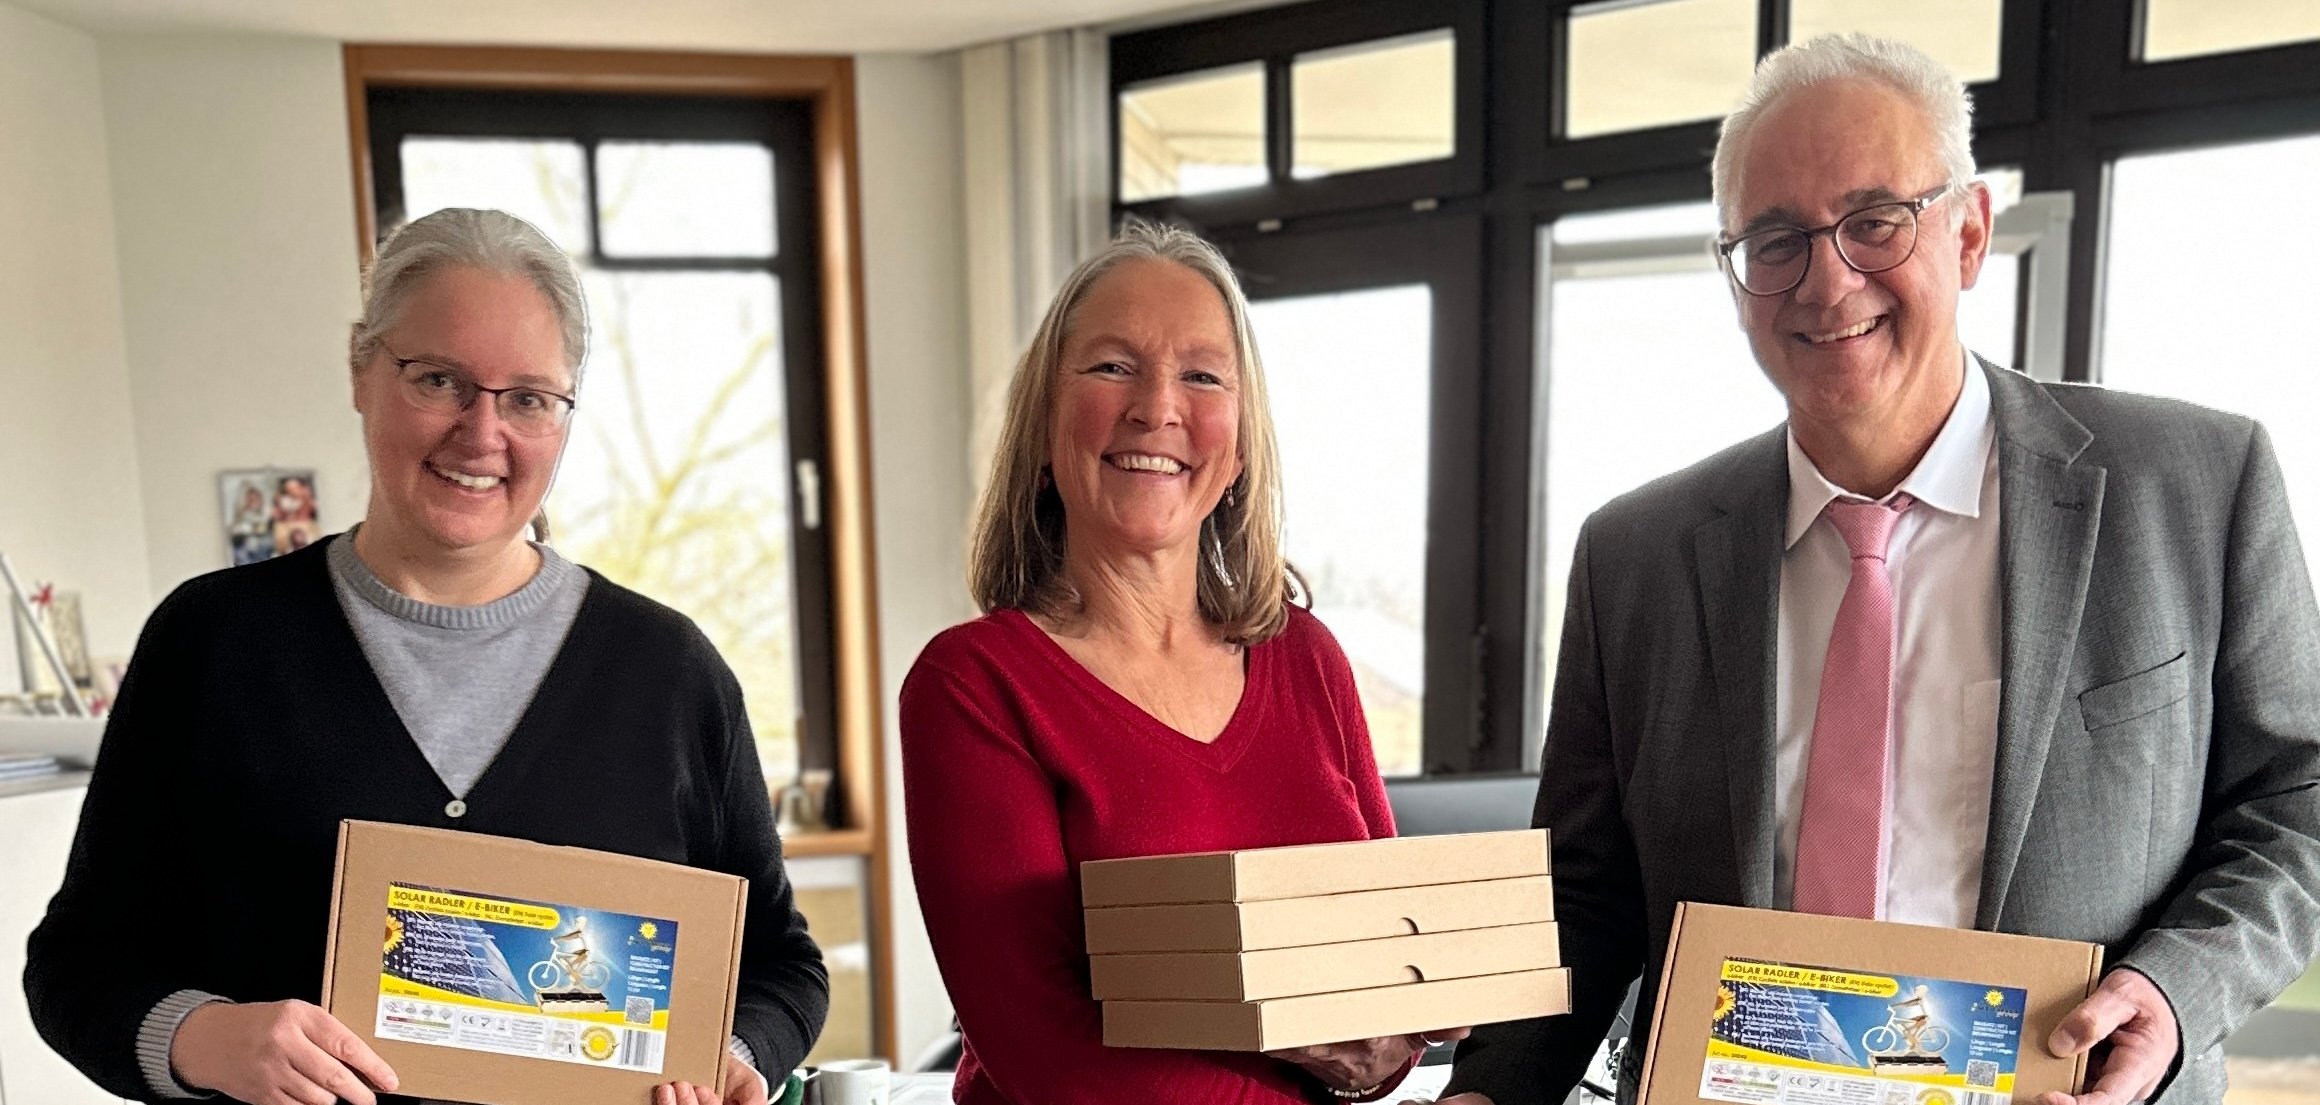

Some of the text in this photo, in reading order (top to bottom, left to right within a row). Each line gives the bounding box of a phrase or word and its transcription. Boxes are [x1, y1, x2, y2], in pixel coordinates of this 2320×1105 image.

[394, 891, 426, 903] SOLAR
[429, 895, 466, 908] RADLER
[475, 902, 511, 914] E-BIKER
[1728, 964, 1761, 975] SOLAR
[1763, 968, 1800, 979] RADLER
[1810, 973, 1847, 984] E-BIKER
